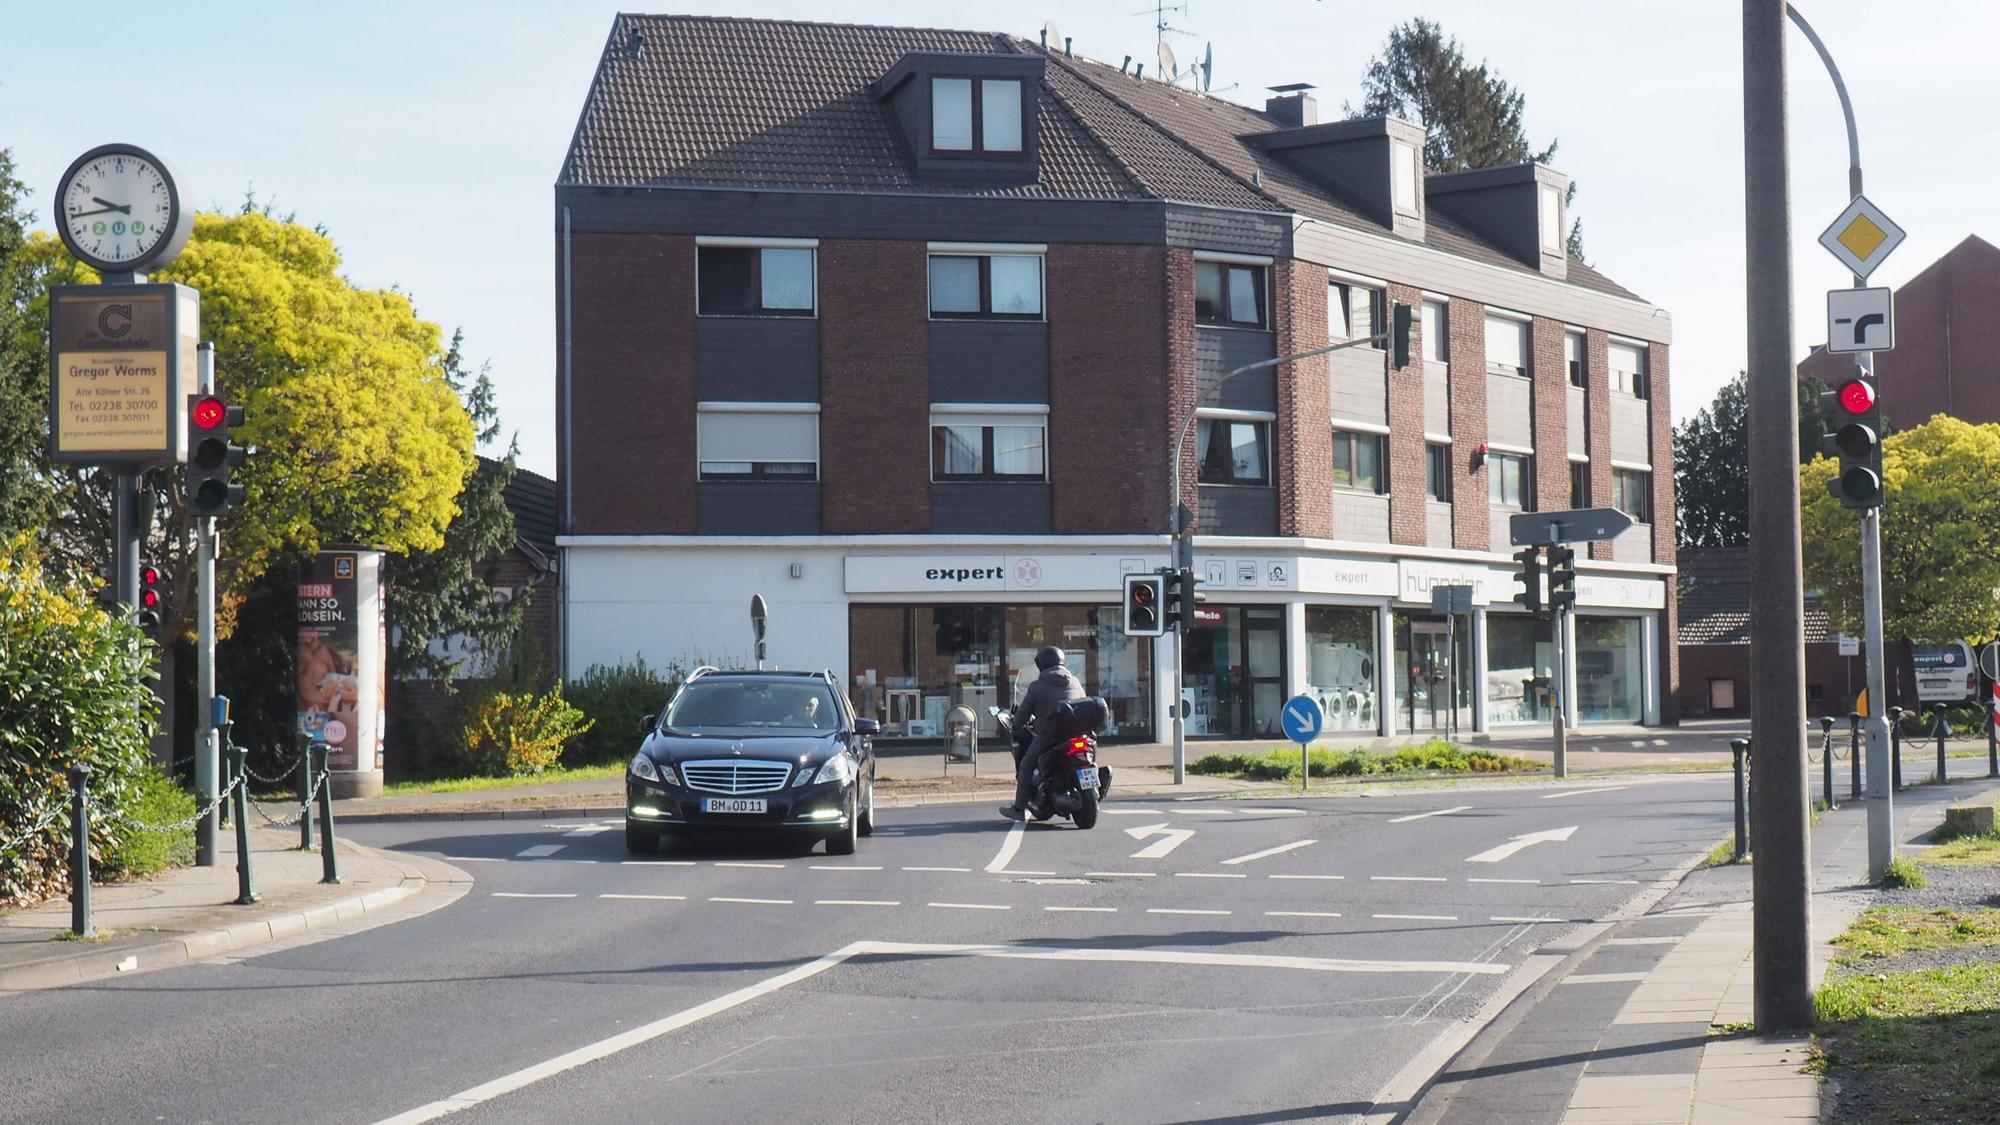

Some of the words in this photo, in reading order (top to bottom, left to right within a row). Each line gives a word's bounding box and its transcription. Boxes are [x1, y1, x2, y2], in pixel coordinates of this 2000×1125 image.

[115, 165, 124, 173] 12
[82, 185, 91, 193] 10
[151, 185, 157, 193] 2
[69, 365, 110, 380] Gregor
[115, 365, 157, 377] Worms
[75, 387, 92, 396] Alte
[95, 387, 120, 396] Kölner
[123, 387, 138, 396] Str.
[69, 401, 86, 411] Tel.
[89, 401, 122, 411] 02238
[126, 400, 158, 410] 30700
[92, 414, 118, 422] 02238
[925, 567, 1004, 582] expert
[1334, 571, 1369, 585] expert
[320, 598, 338, 609] SO
[711, 800, 726, 811] BM
[732, 800, 747, 812] OD
[749, 800, 763, 811] 11
